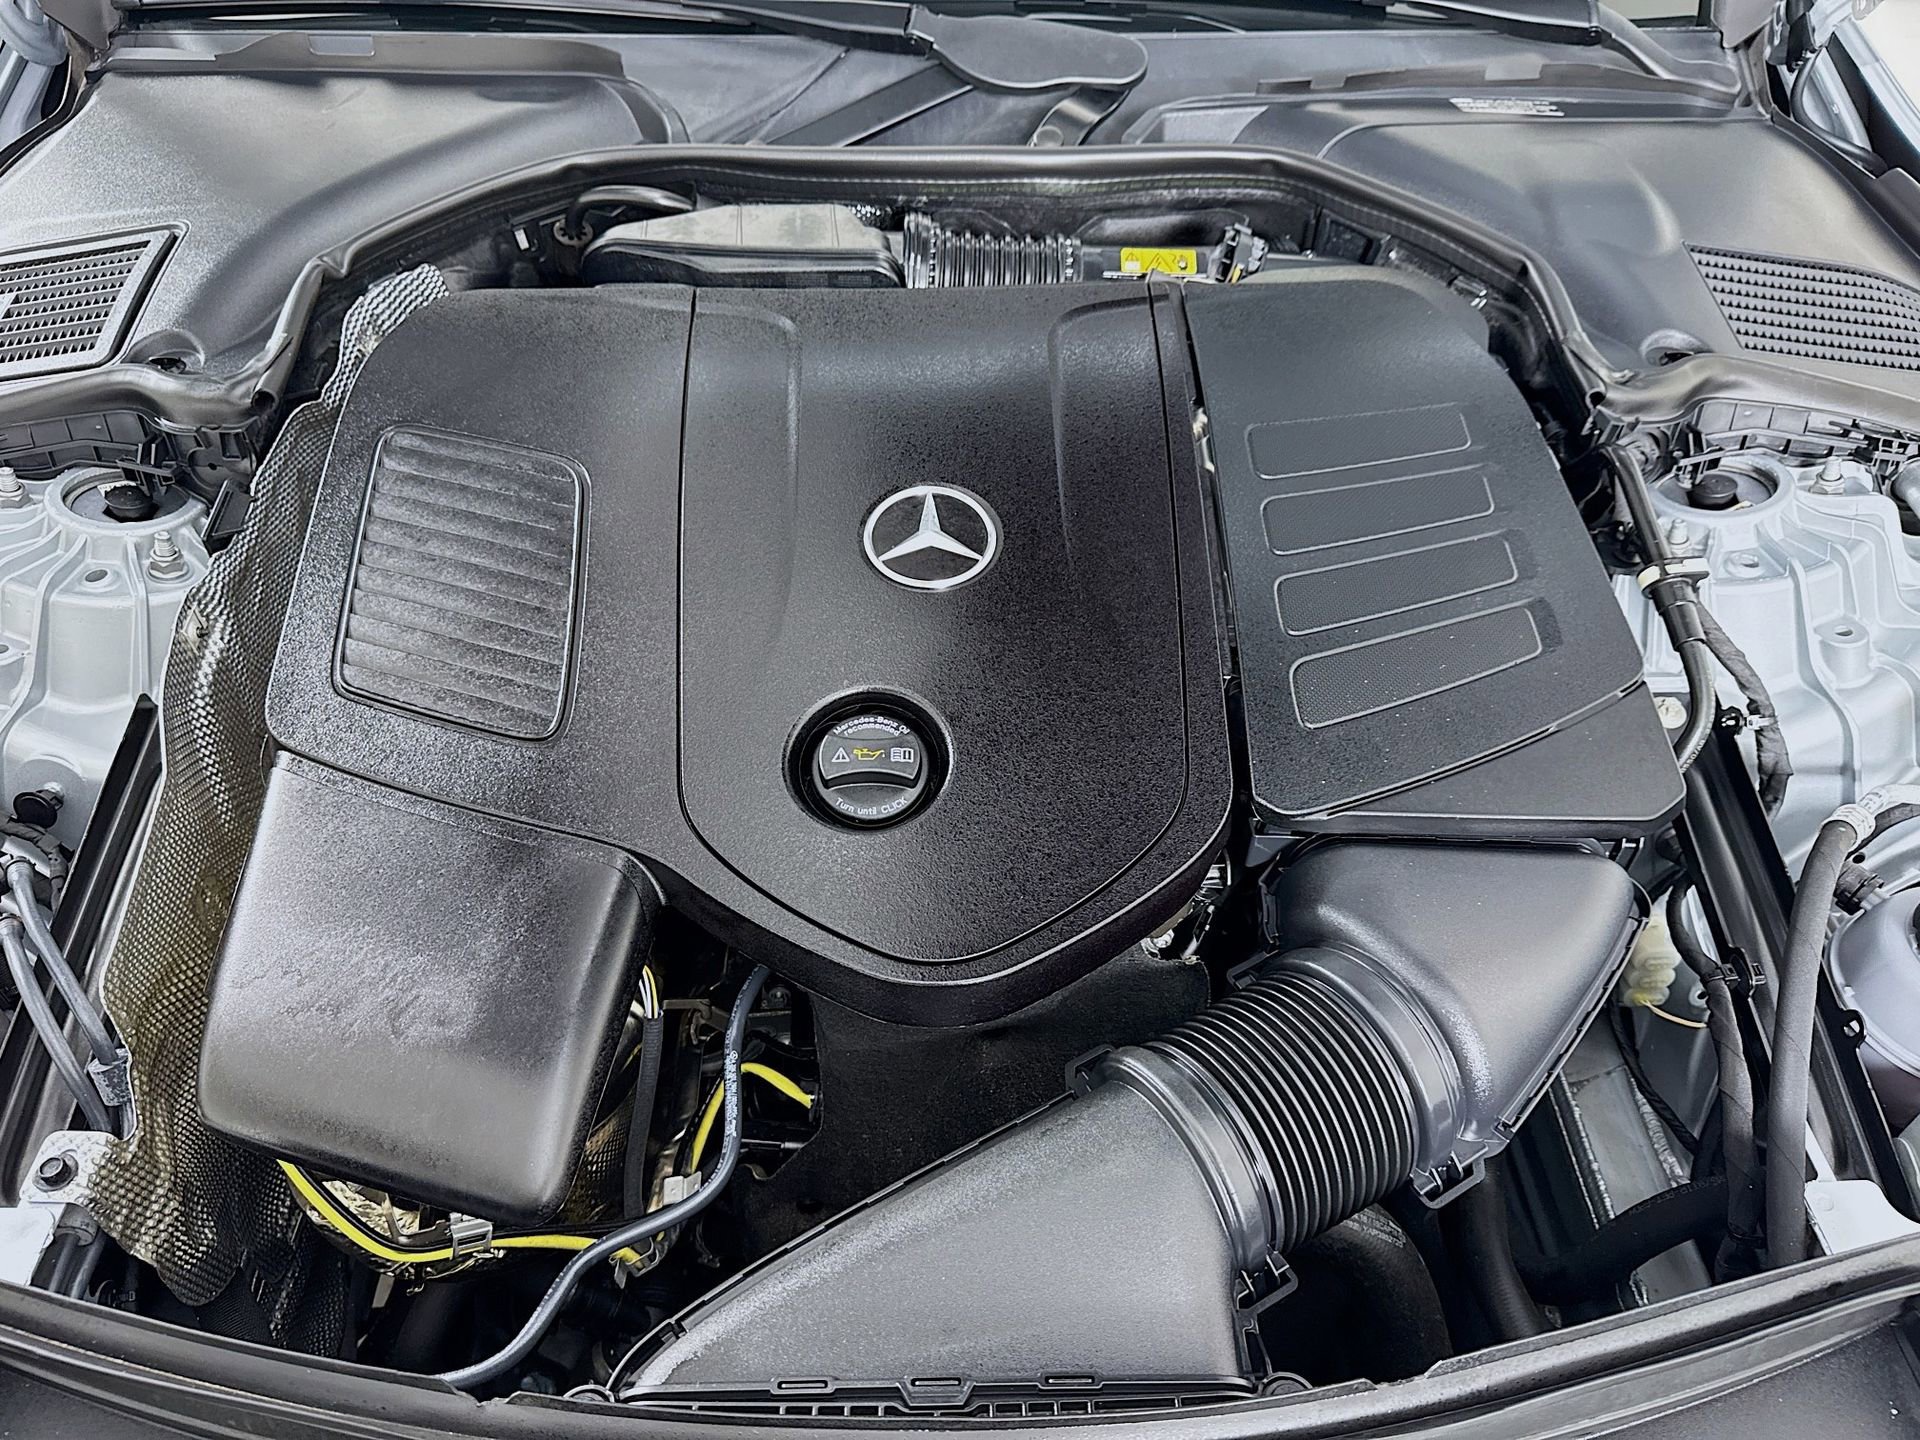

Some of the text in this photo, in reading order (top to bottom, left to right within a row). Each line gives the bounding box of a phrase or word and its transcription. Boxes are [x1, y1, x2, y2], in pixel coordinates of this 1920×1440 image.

[833, 716, 898, 735] Mercedes-Benz
[844, 723, 901, 737] recommended
[835, 797, 908, 815] Turn until CLICK
